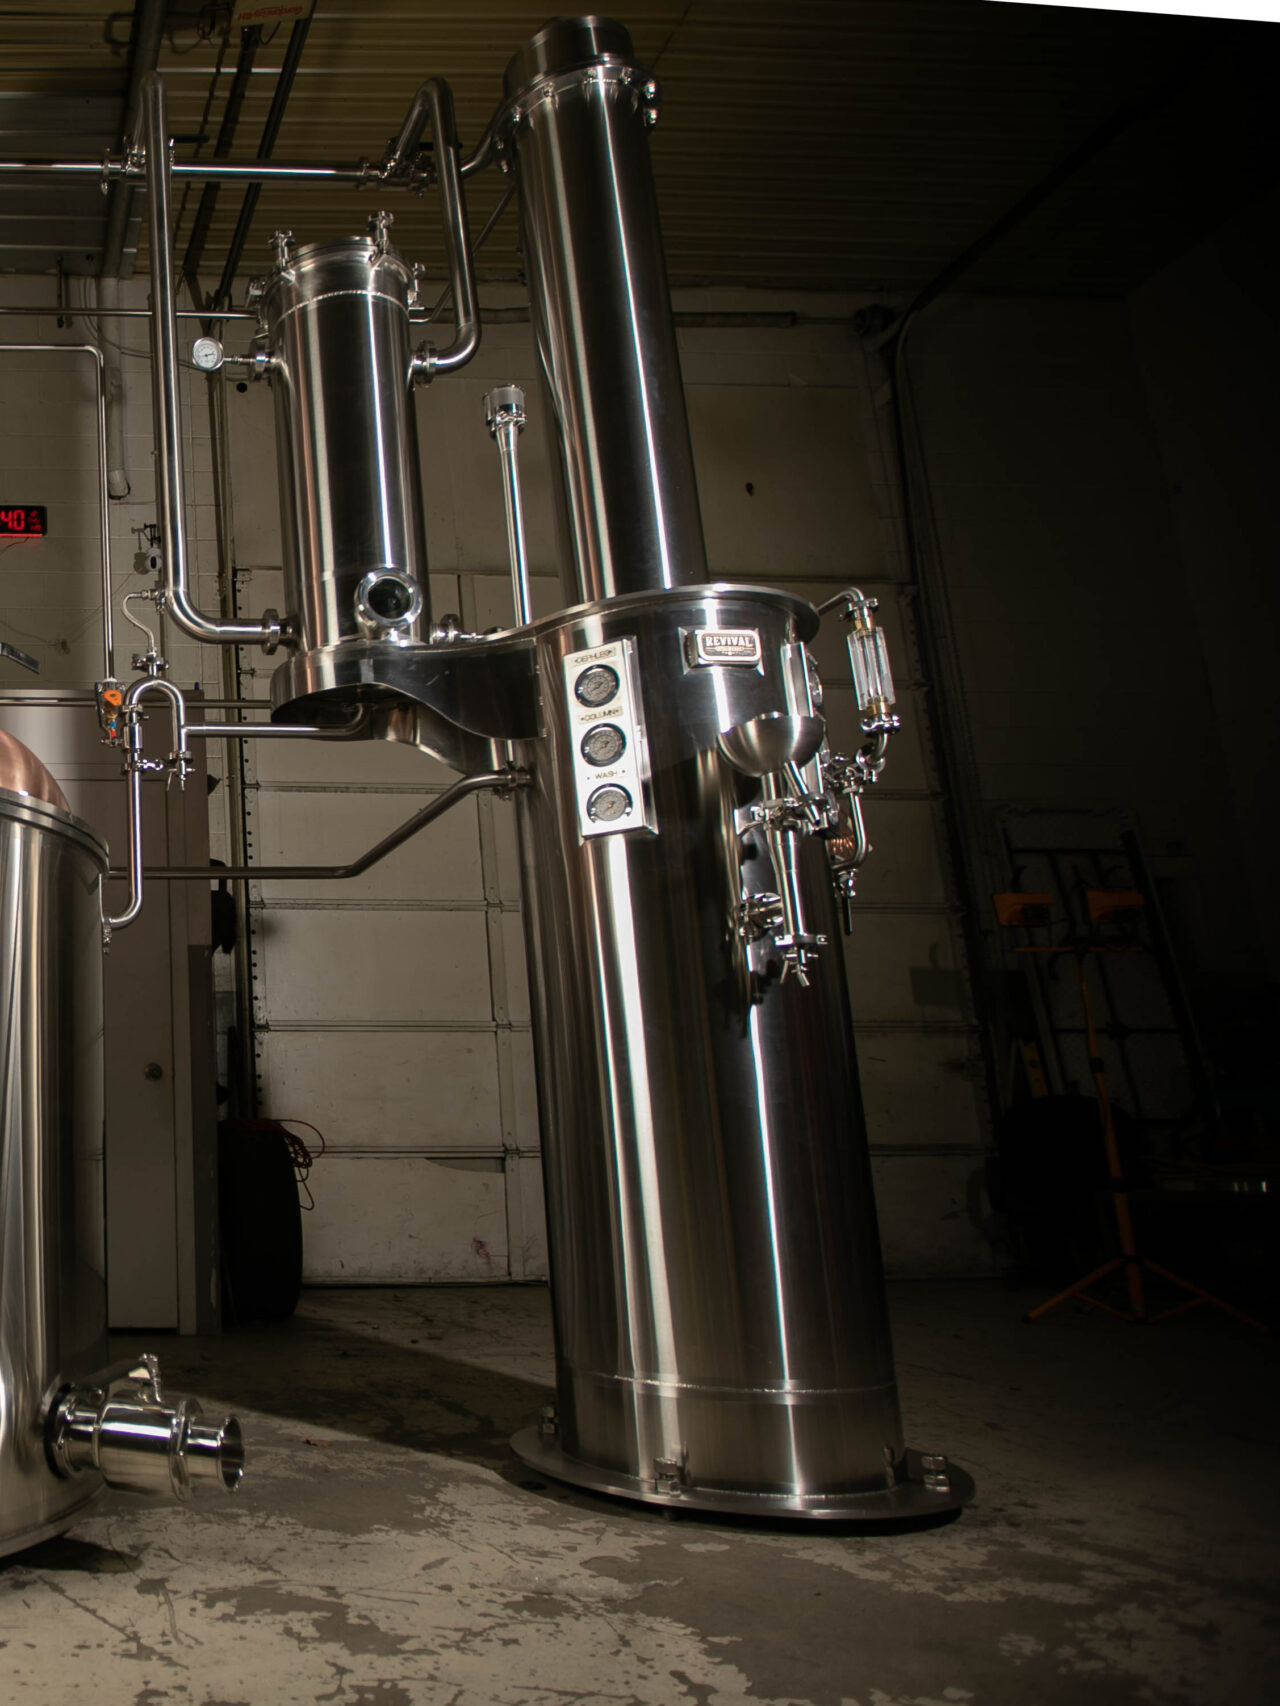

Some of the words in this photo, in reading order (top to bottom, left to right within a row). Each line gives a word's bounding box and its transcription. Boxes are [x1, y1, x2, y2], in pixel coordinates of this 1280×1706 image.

[705, 636, 754, 647] REVIVAL
[584, 708, 614, 721] COLUMN
[595, 770, 618, 780] WASH
